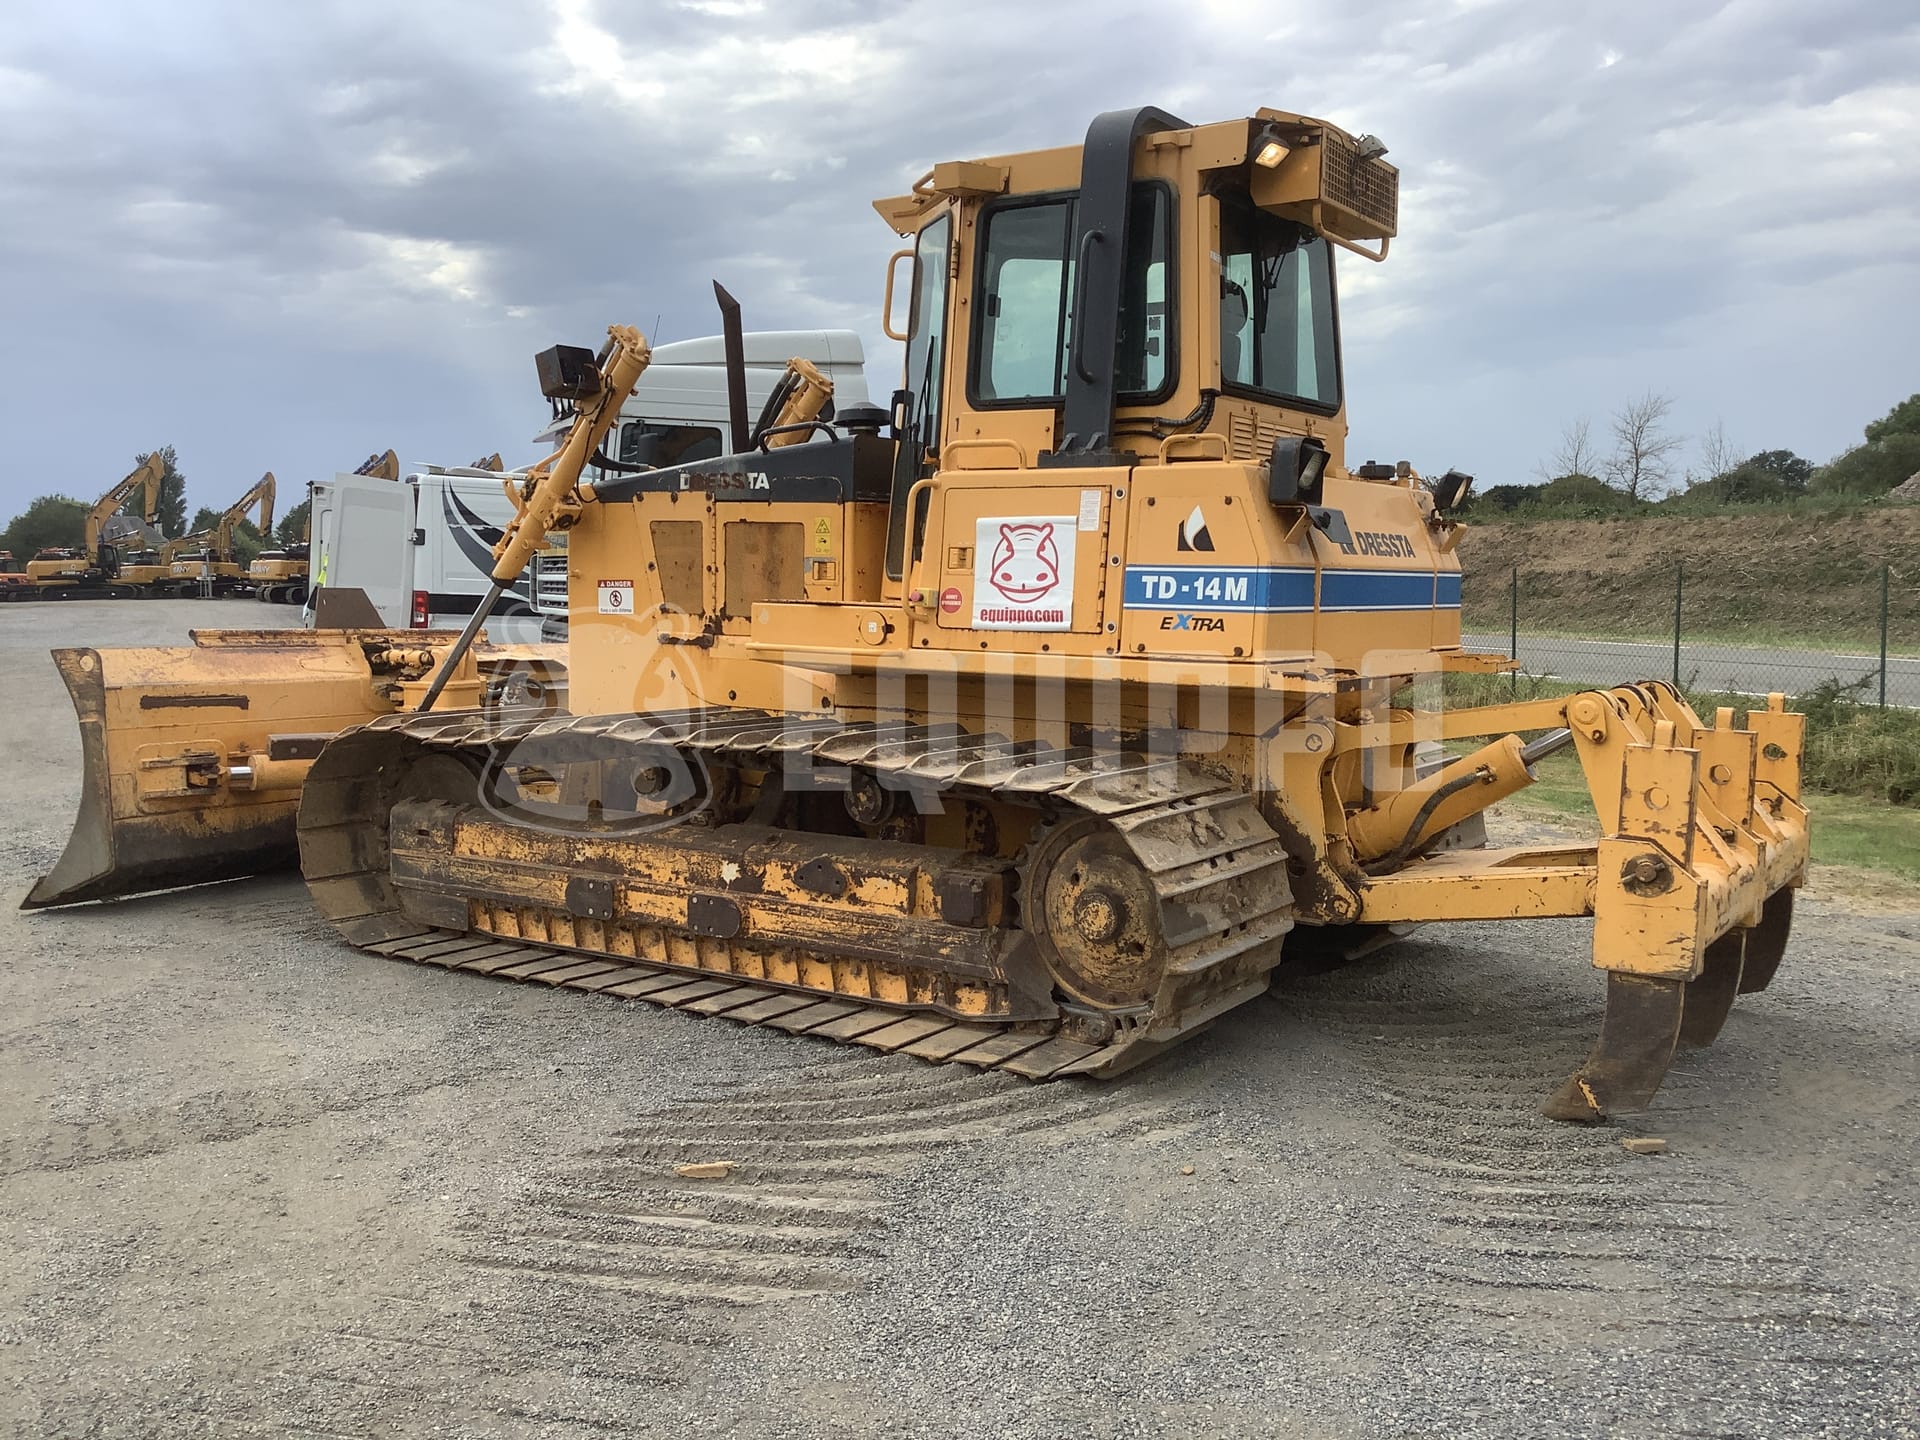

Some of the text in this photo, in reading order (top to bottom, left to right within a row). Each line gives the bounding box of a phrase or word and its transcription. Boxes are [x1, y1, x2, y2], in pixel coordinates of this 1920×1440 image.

[1355, 531, 1416, 558] DRESSTA
[606, 580, 632, 588] DANGER
[980, 606, 1064, 623] equippo.com
[1160, 613, 1225, 632] EXTRA
